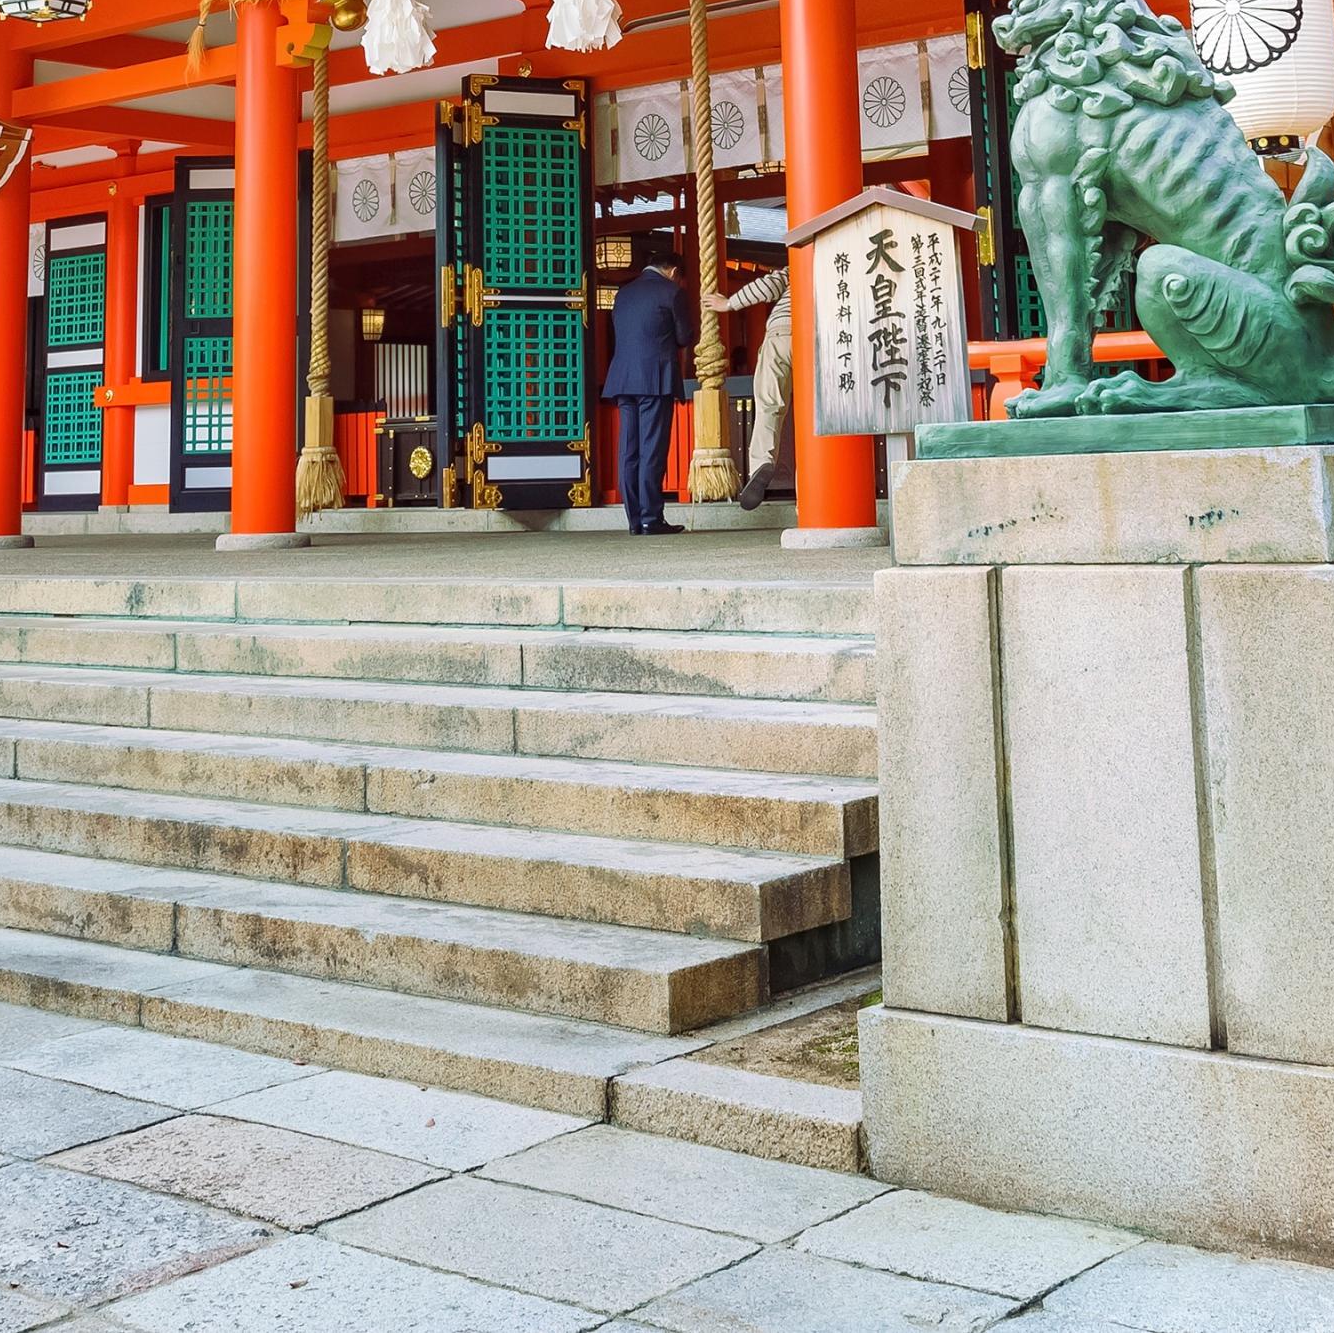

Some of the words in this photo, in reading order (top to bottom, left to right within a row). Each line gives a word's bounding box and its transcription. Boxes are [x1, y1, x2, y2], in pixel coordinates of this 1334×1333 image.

[866, 229, 908, 408] 天皇陛下
[927, 232, 946, 386] 平成二十一年九月二十日
